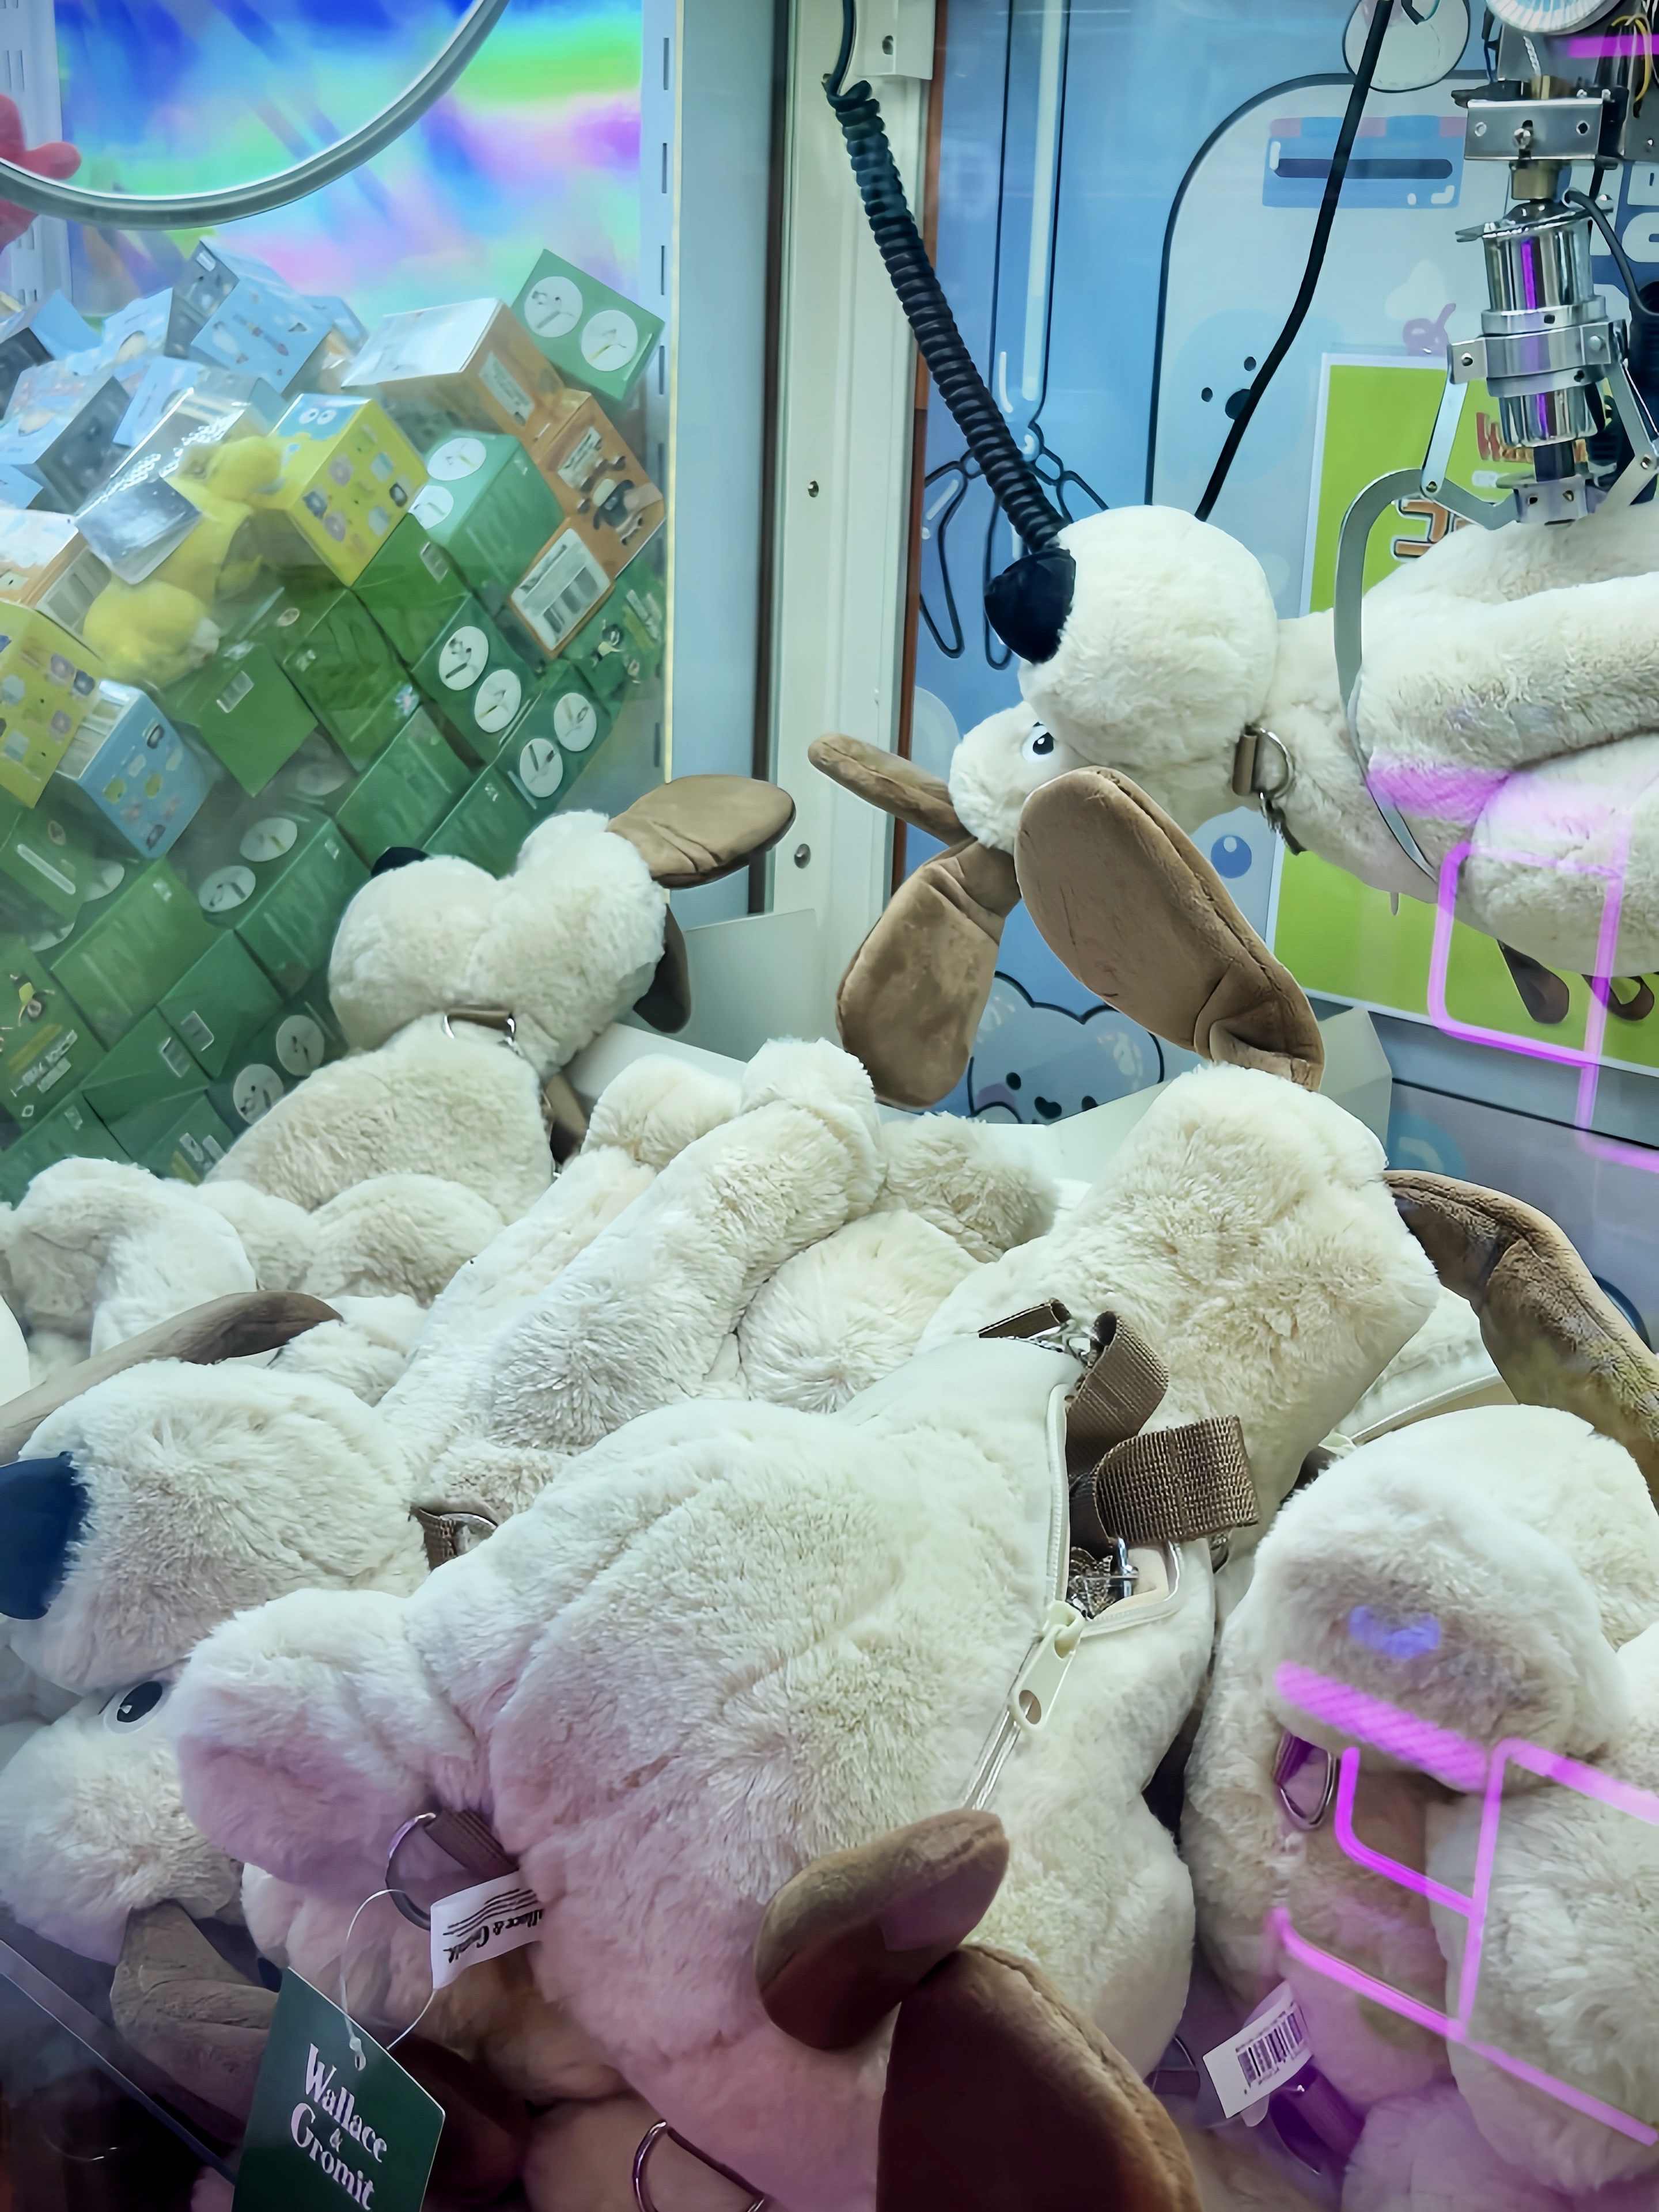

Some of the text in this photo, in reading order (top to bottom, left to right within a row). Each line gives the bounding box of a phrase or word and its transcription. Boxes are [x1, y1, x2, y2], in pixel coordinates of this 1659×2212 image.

[291, 2103, 374, 2211] Gromit
[305, 2043, 387, 2163] Wallace
[329, 2127, 343, 2153] &
